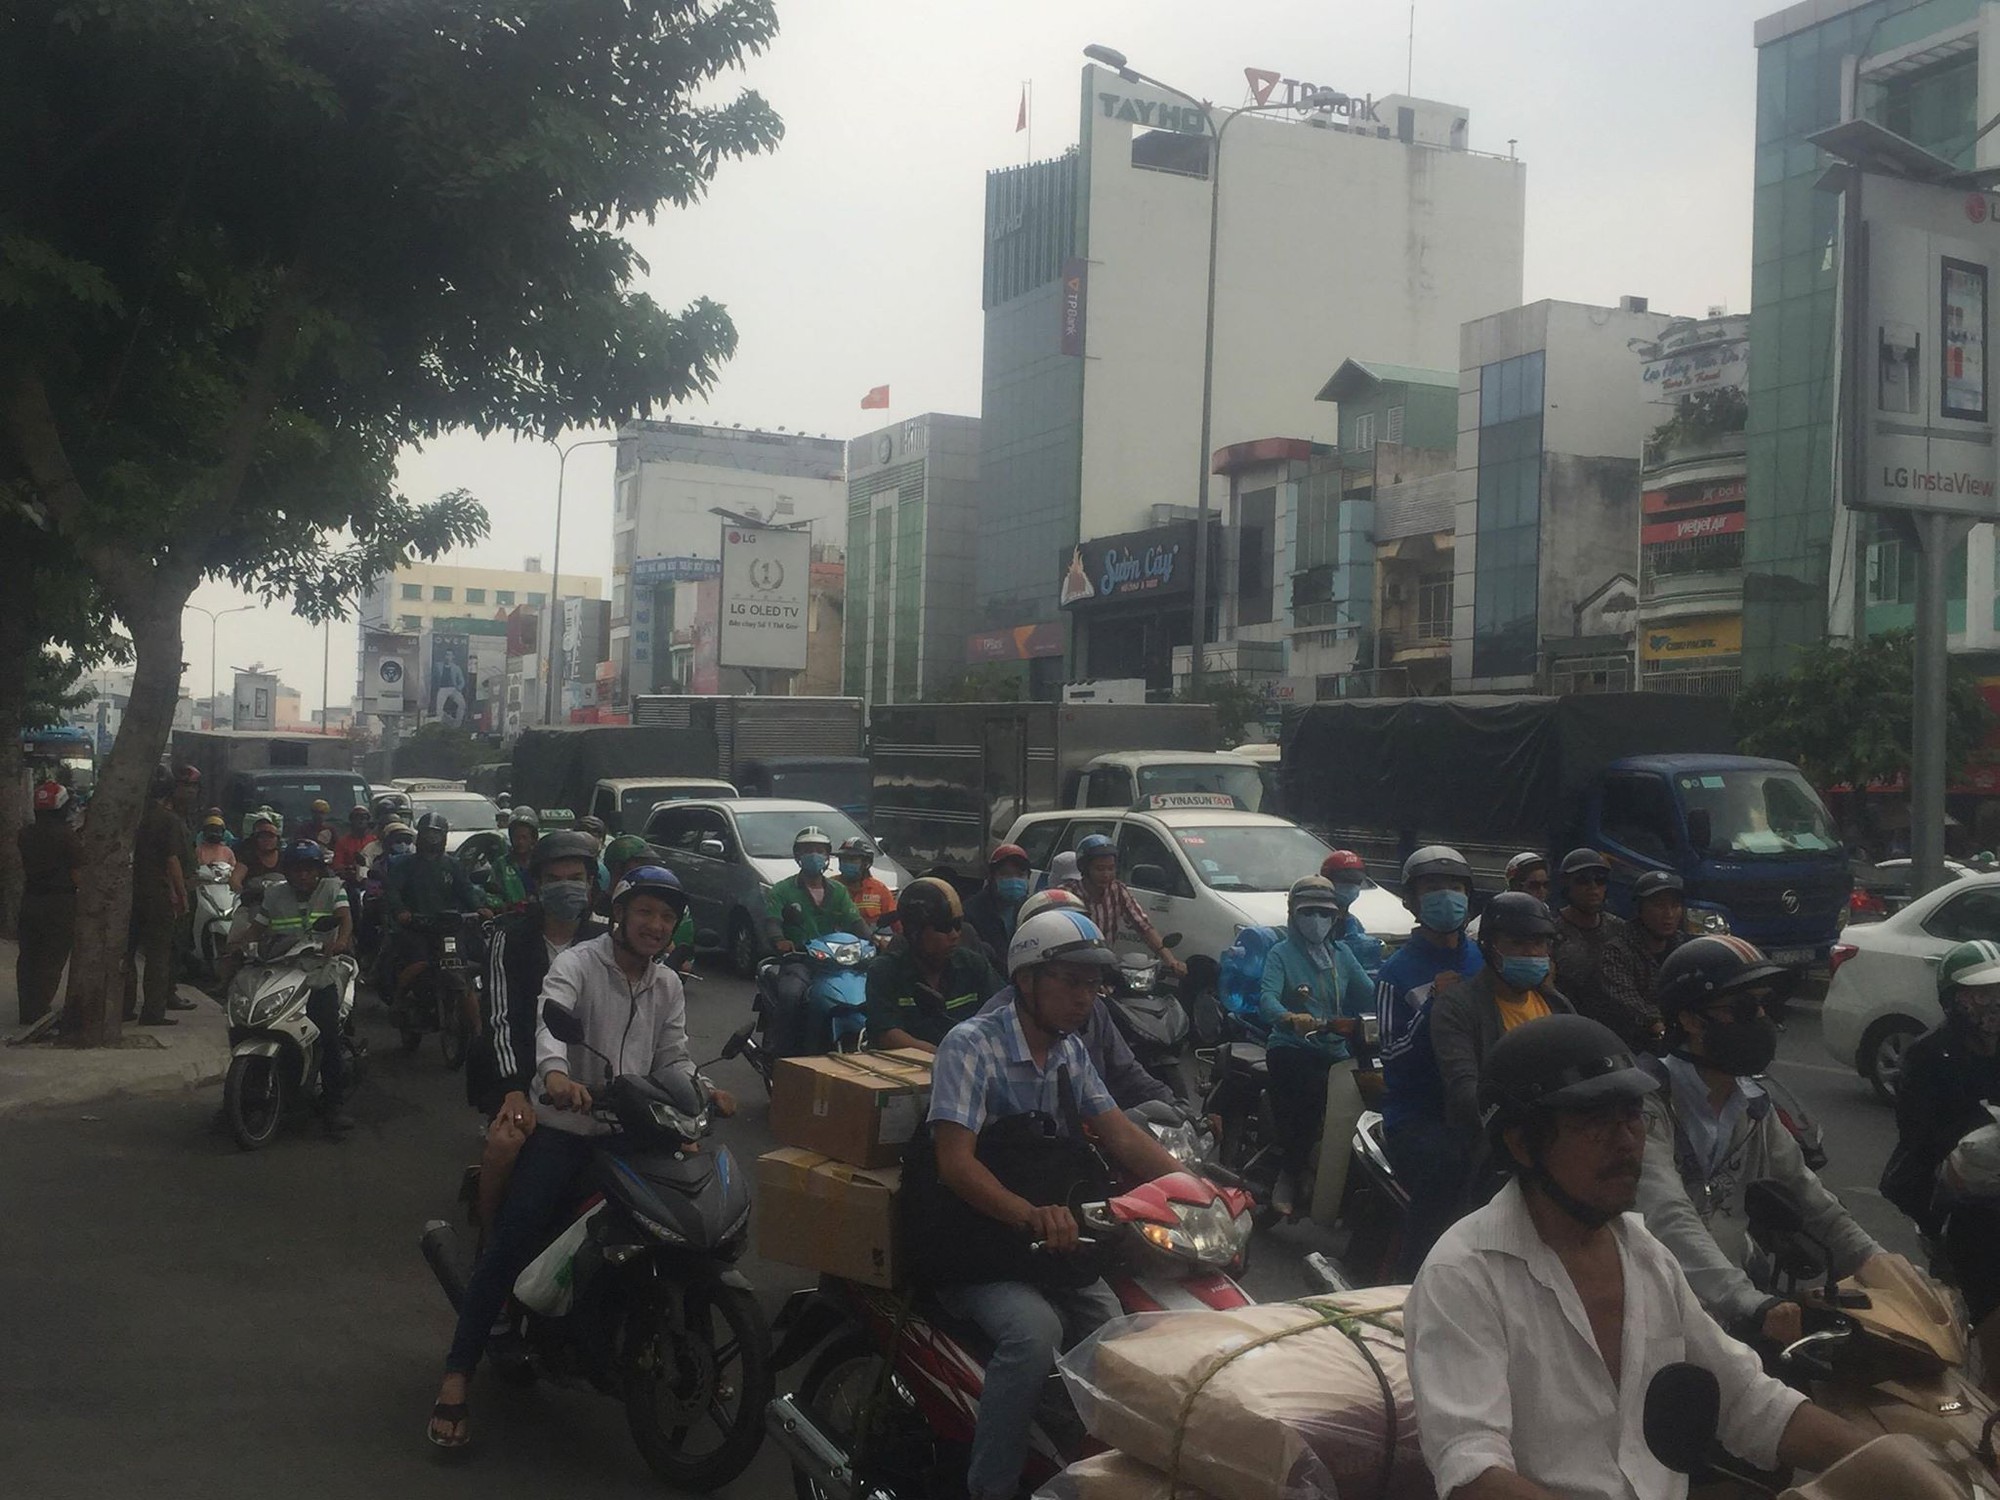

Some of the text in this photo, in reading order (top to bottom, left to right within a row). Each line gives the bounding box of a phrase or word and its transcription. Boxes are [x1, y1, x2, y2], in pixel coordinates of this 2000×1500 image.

[1883, 466, 1994, 497] LG InstaView
[743, 534, 756, 544] LG
[731, 603, 799, 617] LG OLED TV
